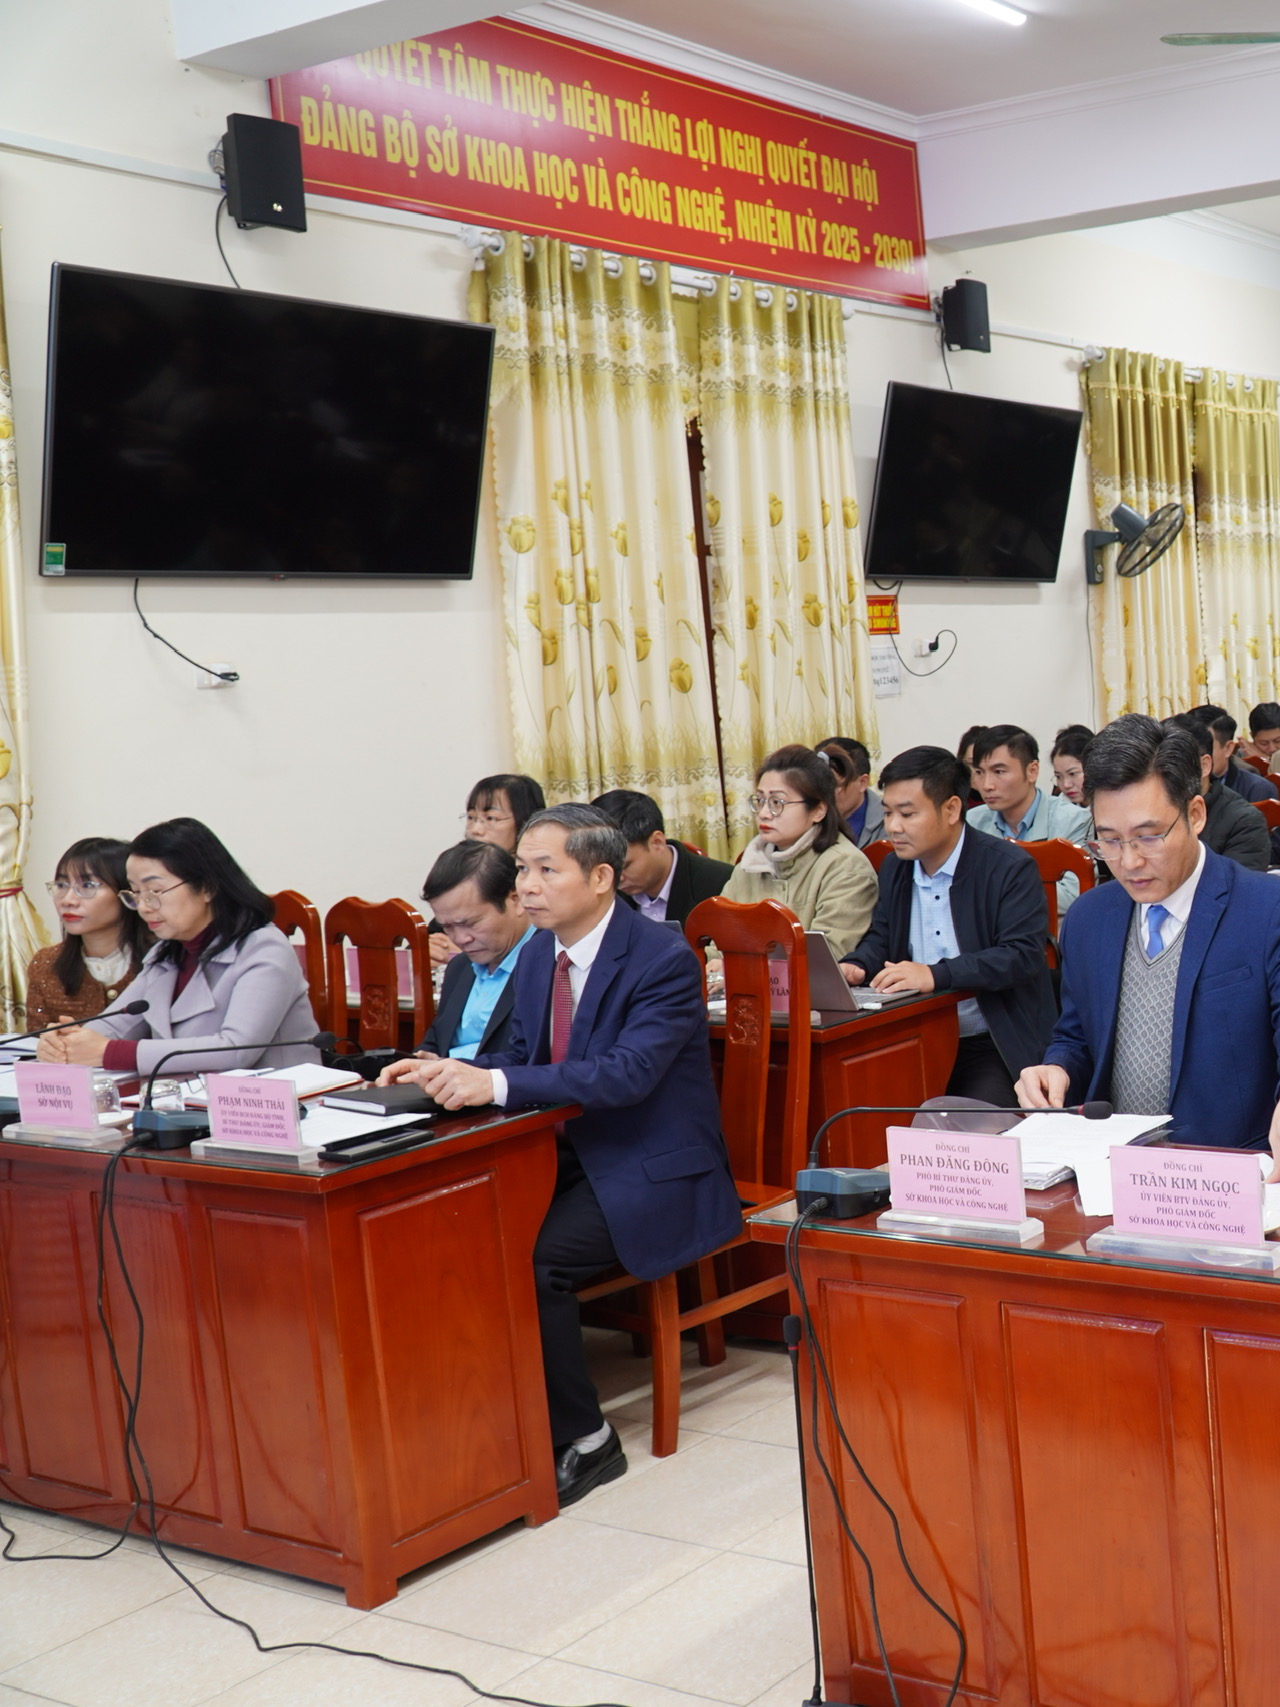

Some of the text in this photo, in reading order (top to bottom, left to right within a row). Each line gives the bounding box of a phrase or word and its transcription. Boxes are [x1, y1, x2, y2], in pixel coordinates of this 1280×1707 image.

[438, 43, 493, 105] TÂM
[496, 64, 556, 128] THỰC
[560, 80, 613, 142] HIỆN
[615, 90, 682, 155] THẮNG
[685, 117, 717, 171] LỢI
[718, 127, 764, 185] NGHỊ
[766, 138, 817, 190] QUYẾT
[821, 154, 850, 204] ĐẠI
[851, 158, 879, 211] HỘI
[301, 84, 378, 158] ĐẢNG
[383, 110, 419, 179] BỘ
[425, 114, 460, 177] SỞ
[464, 134, 530, 193] KHOA
[532, 150, 580, 209] HỌC
[582, 157, 614, 211] VÀ
[616, 166, 672, 224] CÔNG
[675, 187, 733, 244] NGHỆ,
[735, 199, 794, 255] NHIỆM
[795, 207, 817, 254] KỲ
[821, 221, 860, 263] 2025
[218, 1096, 241, 1108] PHẠM
[243, 1098, 263, 1109] NINH
[935, 1142, 970, 1153] ĐỒNG CHÍ
[900, 1153, 1009, 1174] PHAN ĐĂNG ĐÔNG
[1163, 1160, 1203, 1172] ĐỒNG CHÍ
[942, 1174, 958, 1183] THƯ
[1130, 1170, 1240, 1196] TRẦN KIM NGỌC
[946, 1185, 965, 1195] GIÁM
[966, 1186, 982, 1196] ĐỐC
[905, 1192, 1008, 1212] SỞ KHOA HỌC VÀ CÔNG NGHỆ
[1153, 1192, 1174, 1203] VIÊN
[1174, 1195, 1191, 1205] BTV
[1192, 1195, 1216, 1207] ĐẢNG
[1156, 1204, 1216, 1219] PHÓ GIÁM ĐỐC
[1129, 1213, 1246, 1235] SỞ KHOA HỌC VÀ CÔNG NGHỆ
